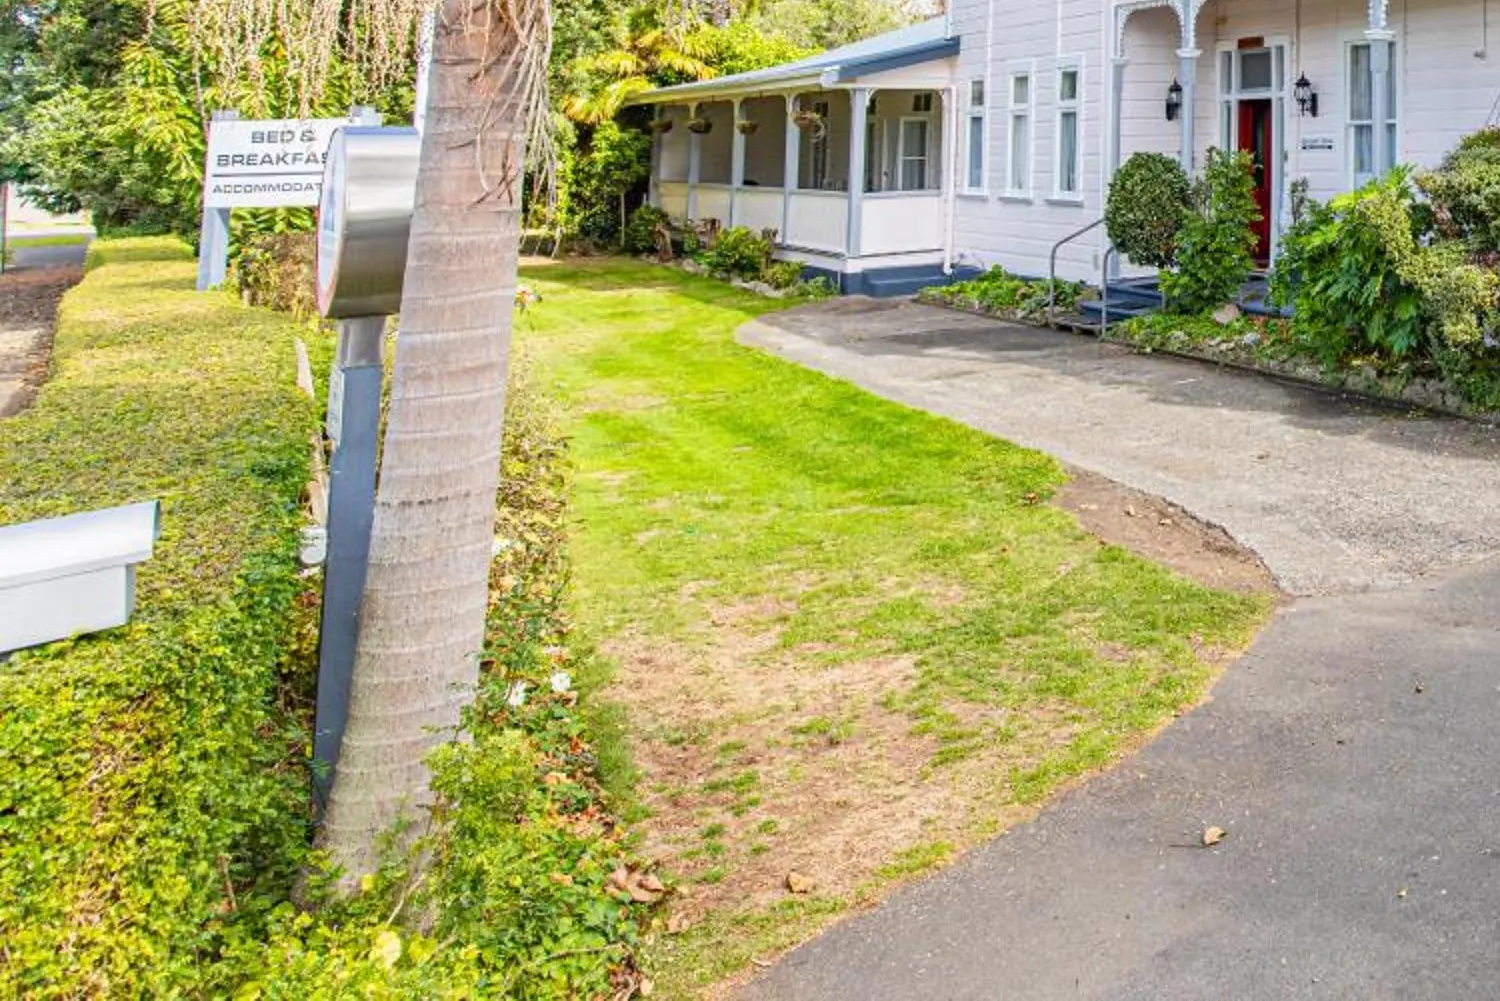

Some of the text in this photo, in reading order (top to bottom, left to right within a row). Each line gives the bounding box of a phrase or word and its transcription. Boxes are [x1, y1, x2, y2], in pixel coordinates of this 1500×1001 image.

[251, 129, 317, 144] BED &
[217, 151, 329, 167] BREAKFAS
[212, 182, 323, 194] ACCOMMODAT
